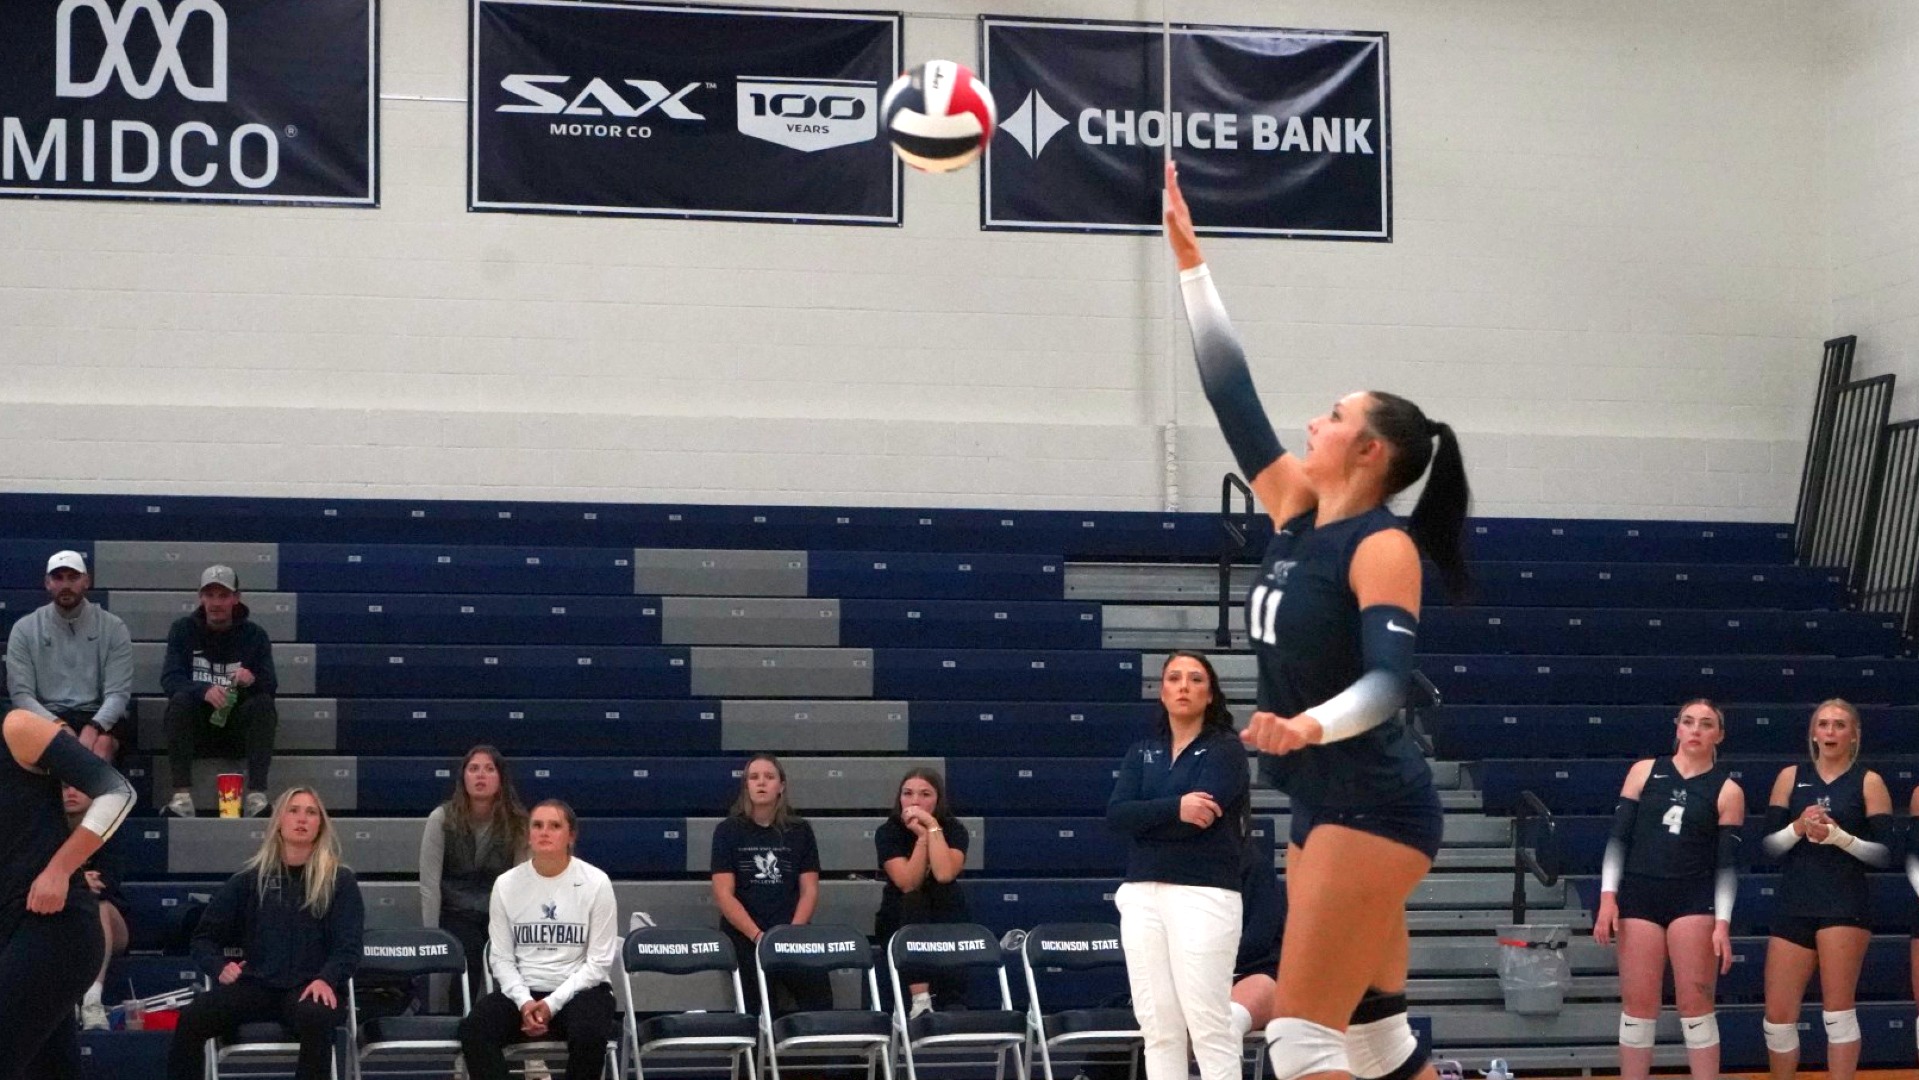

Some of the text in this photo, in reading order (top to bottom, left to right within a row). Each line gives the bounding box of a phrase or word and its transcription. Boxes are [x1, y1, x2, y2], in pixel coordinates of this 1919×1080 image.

[495, 74, 706, 121] SAX
[749, 92, 866, 120] 100
[549, 123, 652, 138] MOTOR CO
[786, 123, 830, 134] YEARS
[1078, 107, 1374, 155] CHOICE BANK
[2, 116, 279, 189] MIDCO
[1250, 585, 1284, 646] 11
[1661, 805, 1686, 835] 4
[513, 924, 585, 944] VOLLEYBALL
[363, 943, 449, 957] DICKINSON STATE
[638, 941, 720, 954] DICKINSON STATE
[774, 941, 856, 953] DICKINSON STATE
[906, 939, 986, 952] DICKINSON STATE
[1041, 939, 1119, 951] DICKINSON STATE
